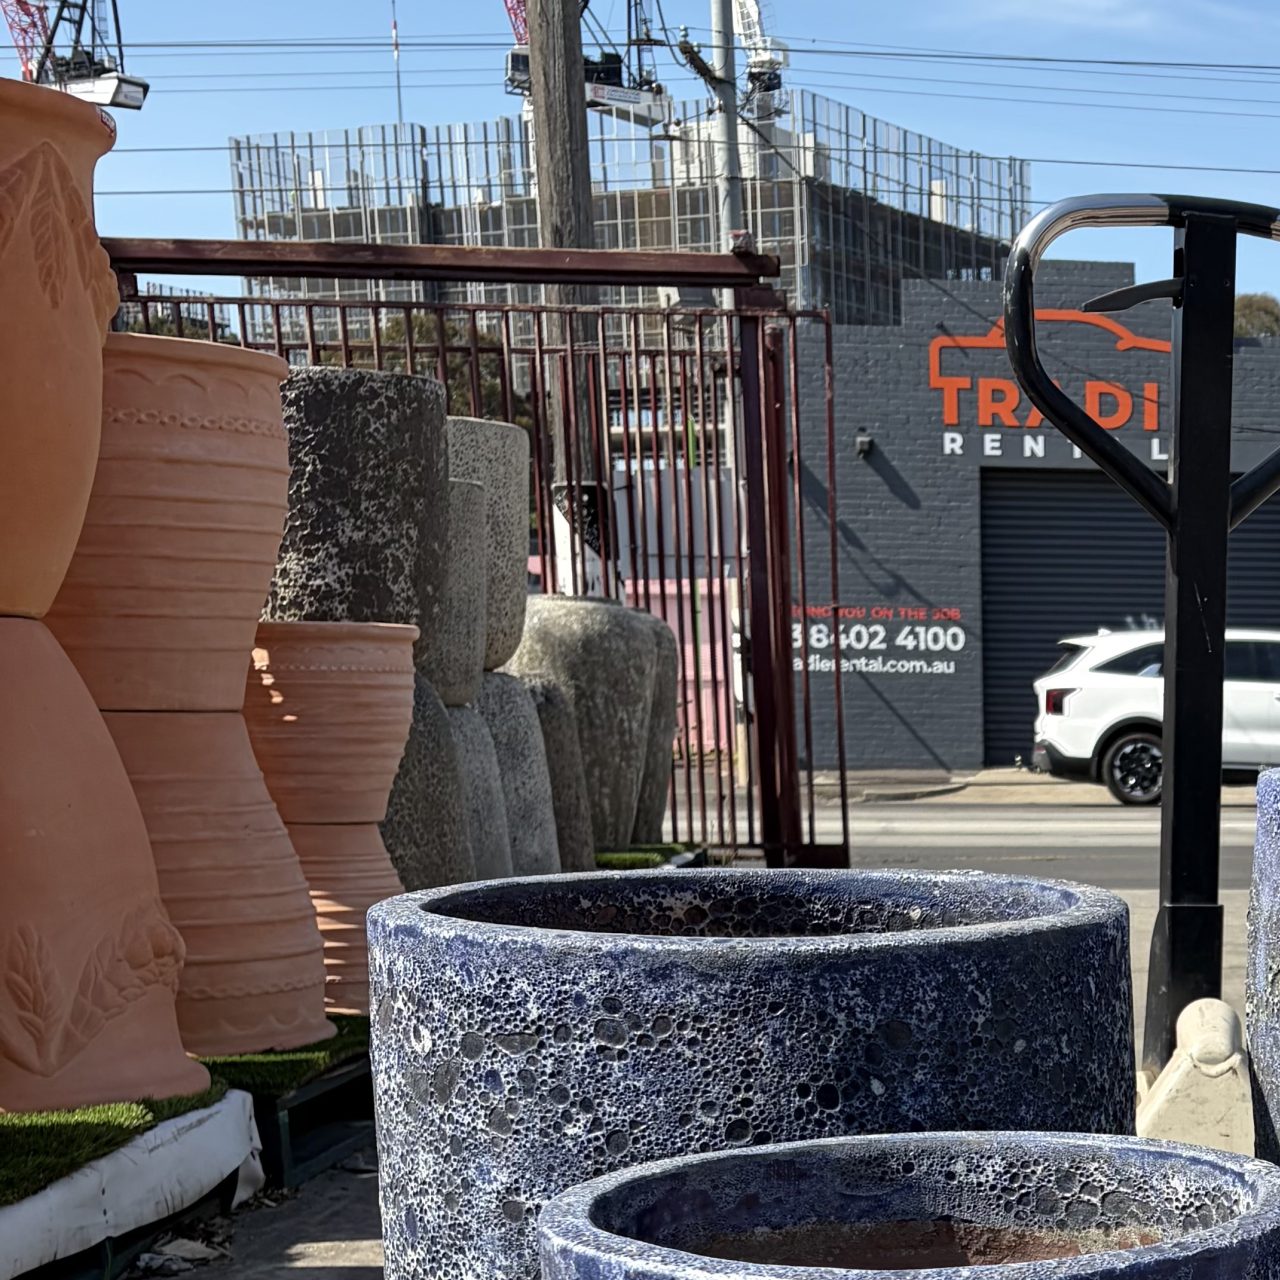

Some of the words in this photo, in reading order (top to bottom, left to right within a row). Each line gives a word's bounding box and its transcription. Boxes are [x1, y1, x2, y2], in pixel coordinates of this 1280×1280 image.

[871, 606, 894, 621] ON
[899, 606, 927, 621] THE
[932, 607, 961, 621] JOB
[809, 624, 887, 650] 8402
[895, 625, 966, 651] 4100
